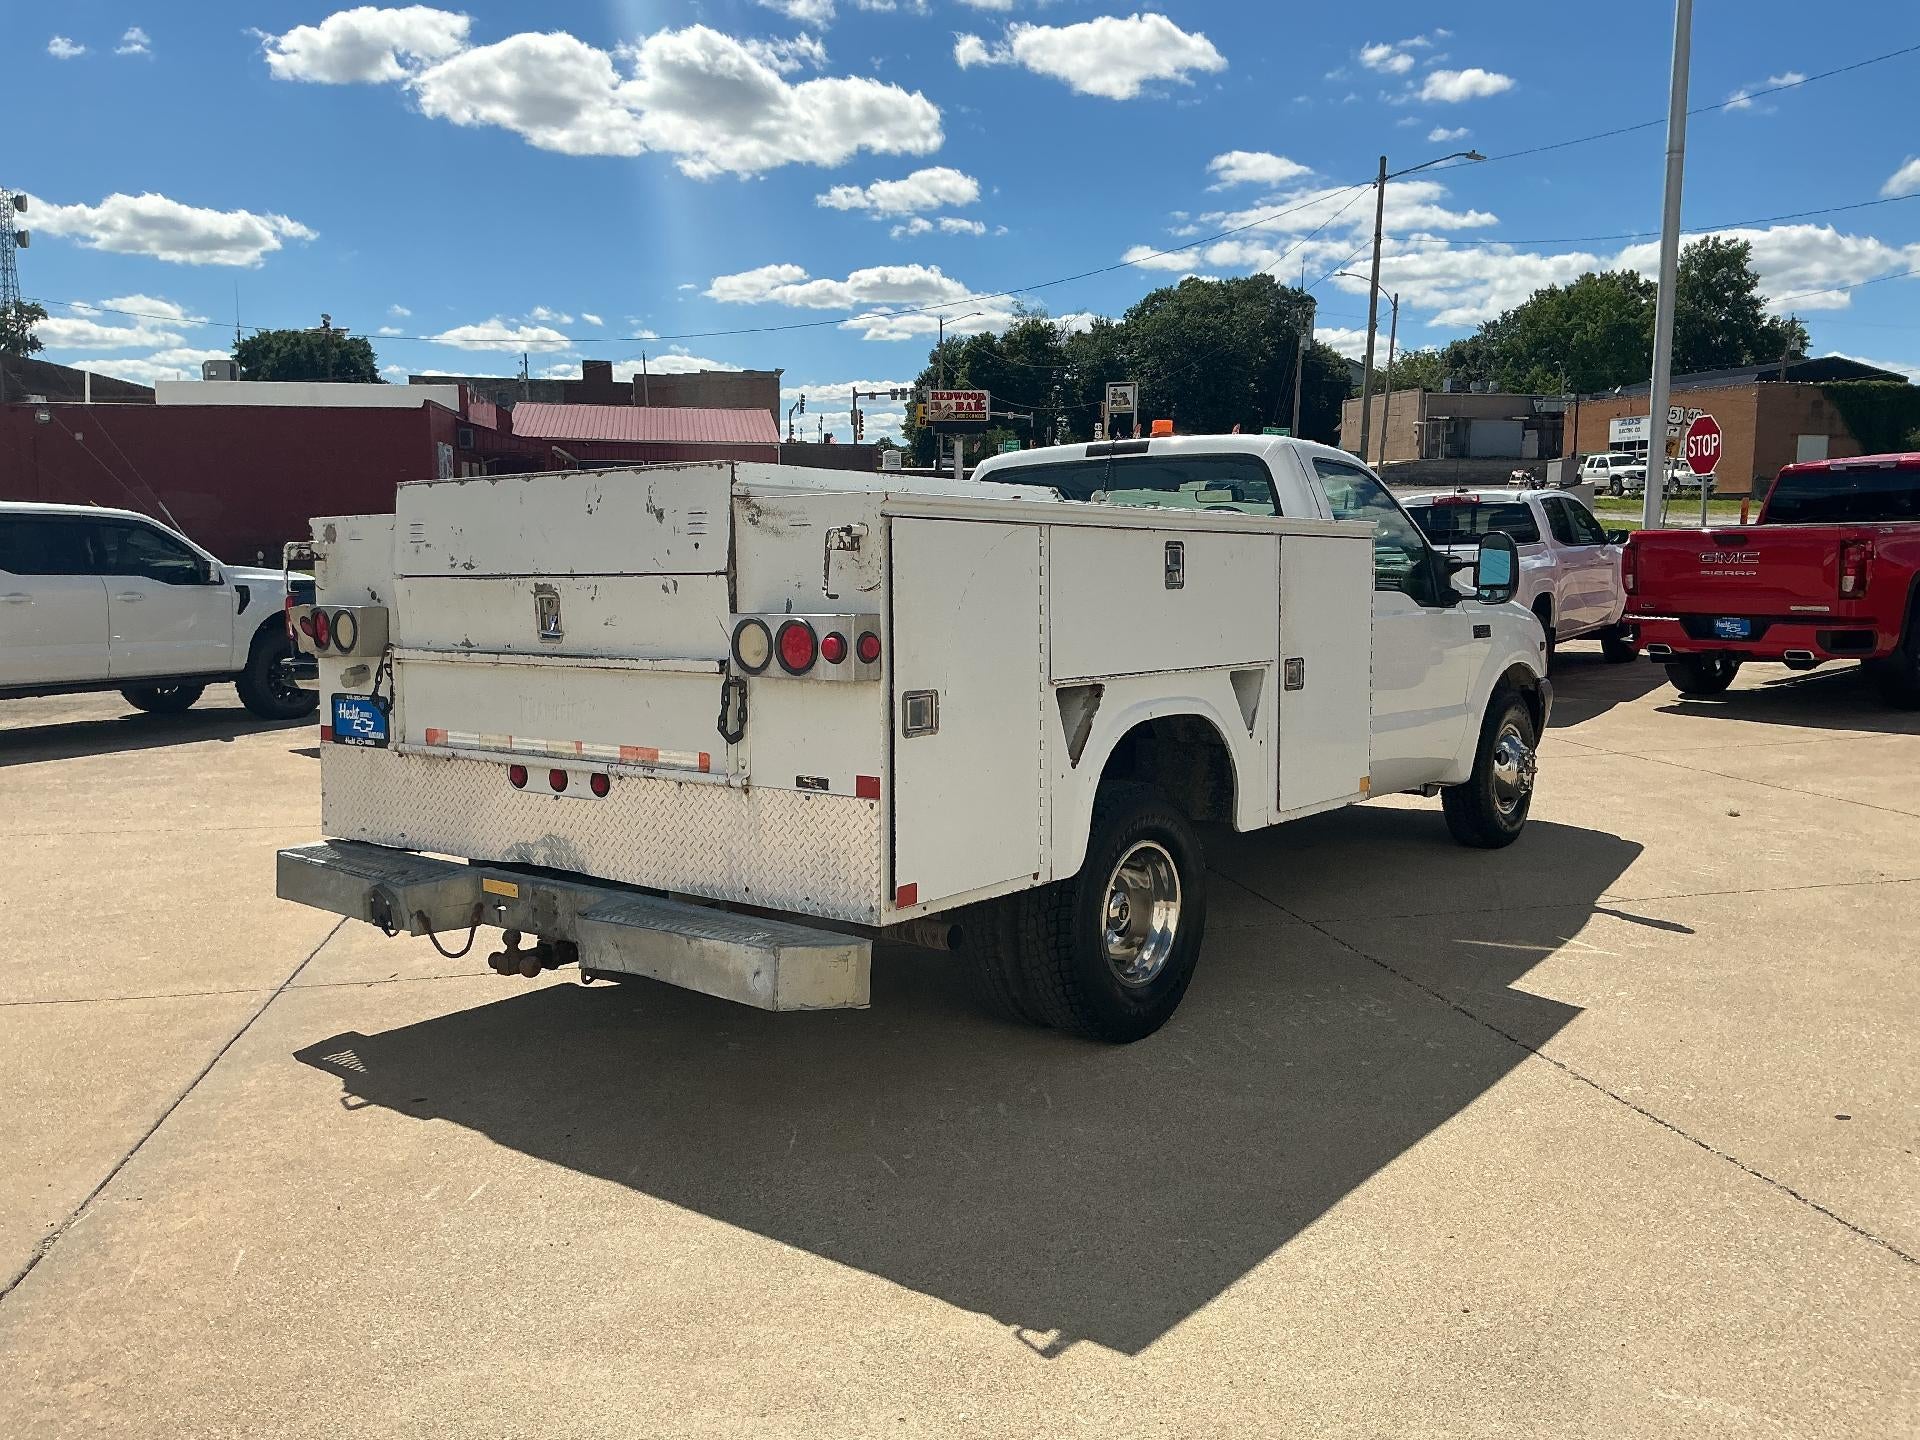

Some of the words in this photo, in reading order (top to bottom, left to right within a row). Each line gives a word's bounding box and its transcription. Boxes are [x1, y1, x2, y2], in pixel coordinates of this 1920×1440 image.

[931, 391, 986, 400] REDWOOD
[955, 401, 986, 411] BAR
[1670, 409, 1682, 420] 51
[1688, 433, 1720, 458] STOP
[1699, 551, 1760, 564] GMC
